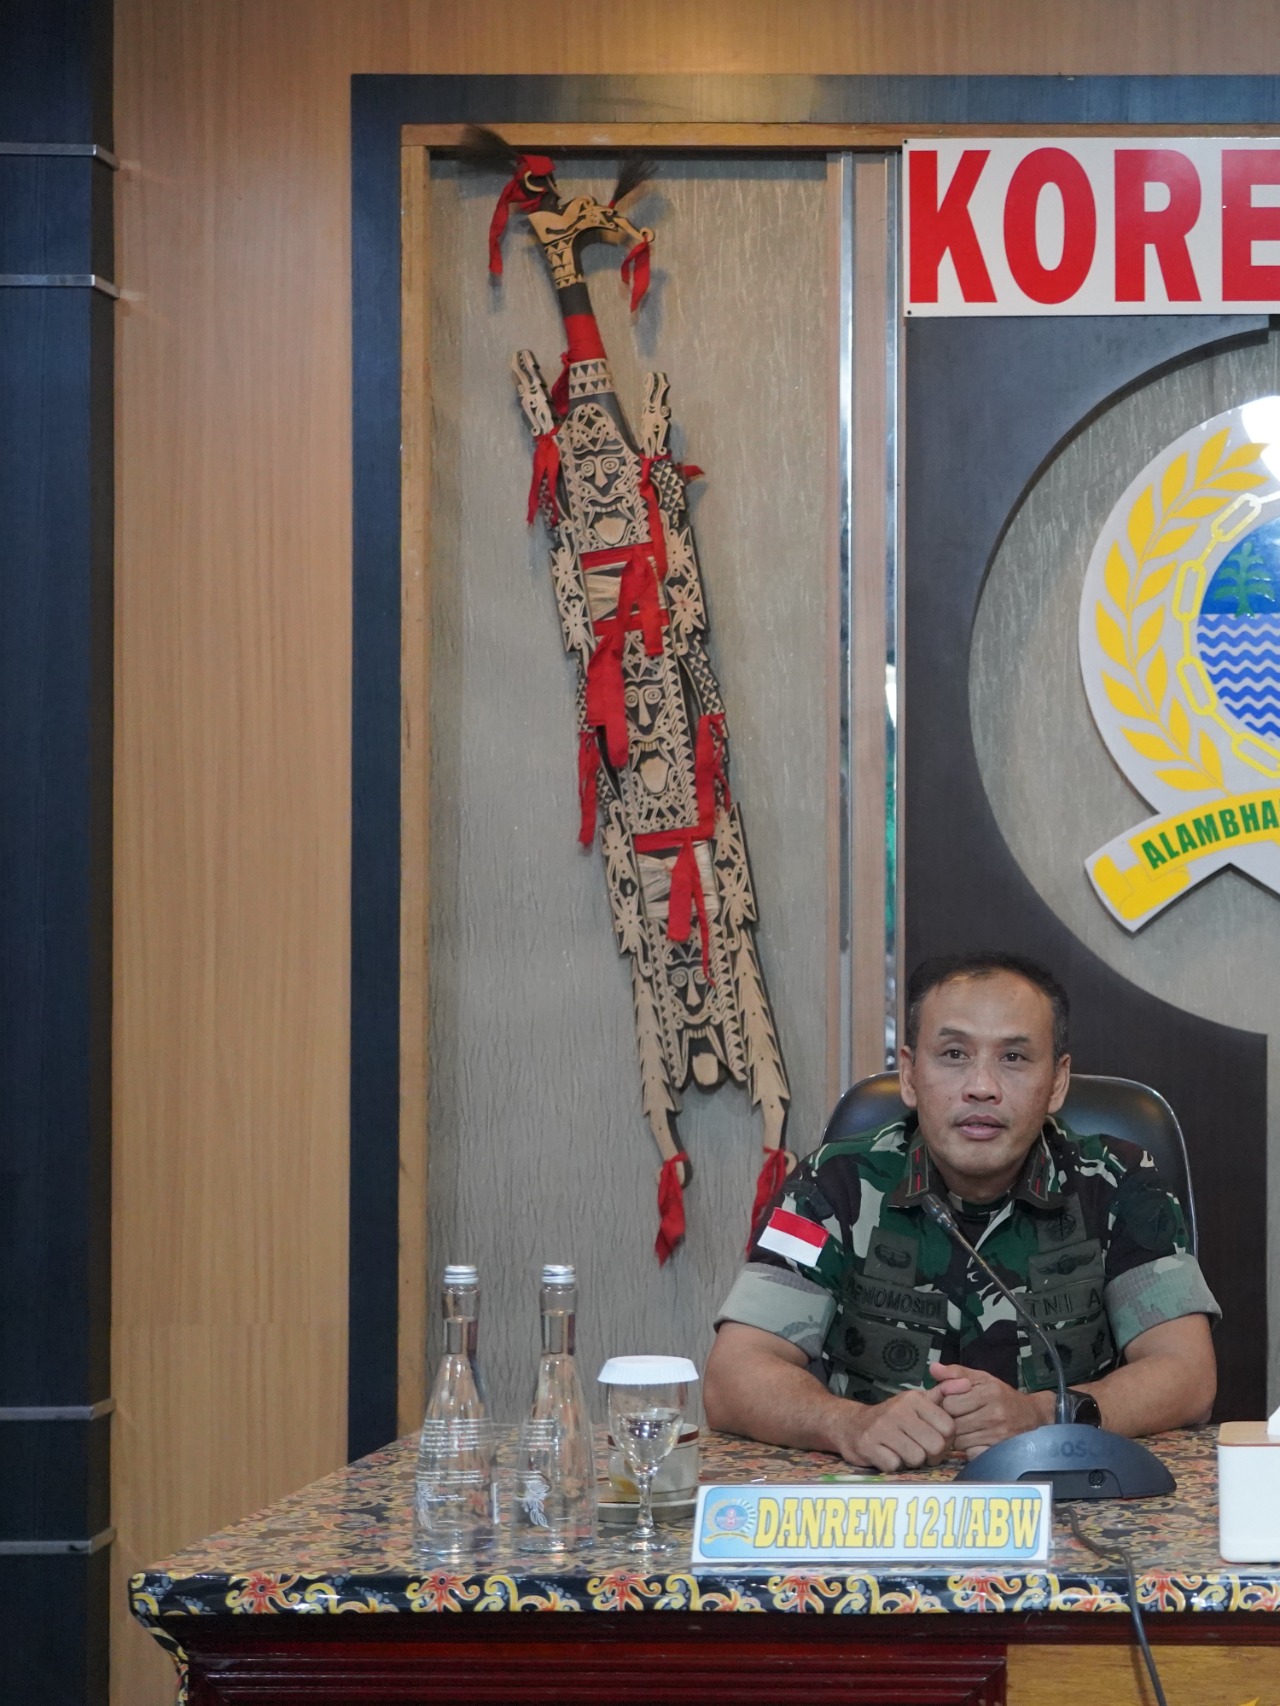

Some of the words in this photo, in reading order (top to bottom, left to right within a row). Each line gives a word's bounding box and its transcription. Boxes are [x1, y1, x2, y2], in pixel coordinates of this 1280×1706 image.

[1024, 1293, 1073, 1318] TNI
[1087, 1287, 1102, 1309] A
[753, 1496, 898, 1549] DANREM
[905, 1496, 1043, 1549] 121/ABW
